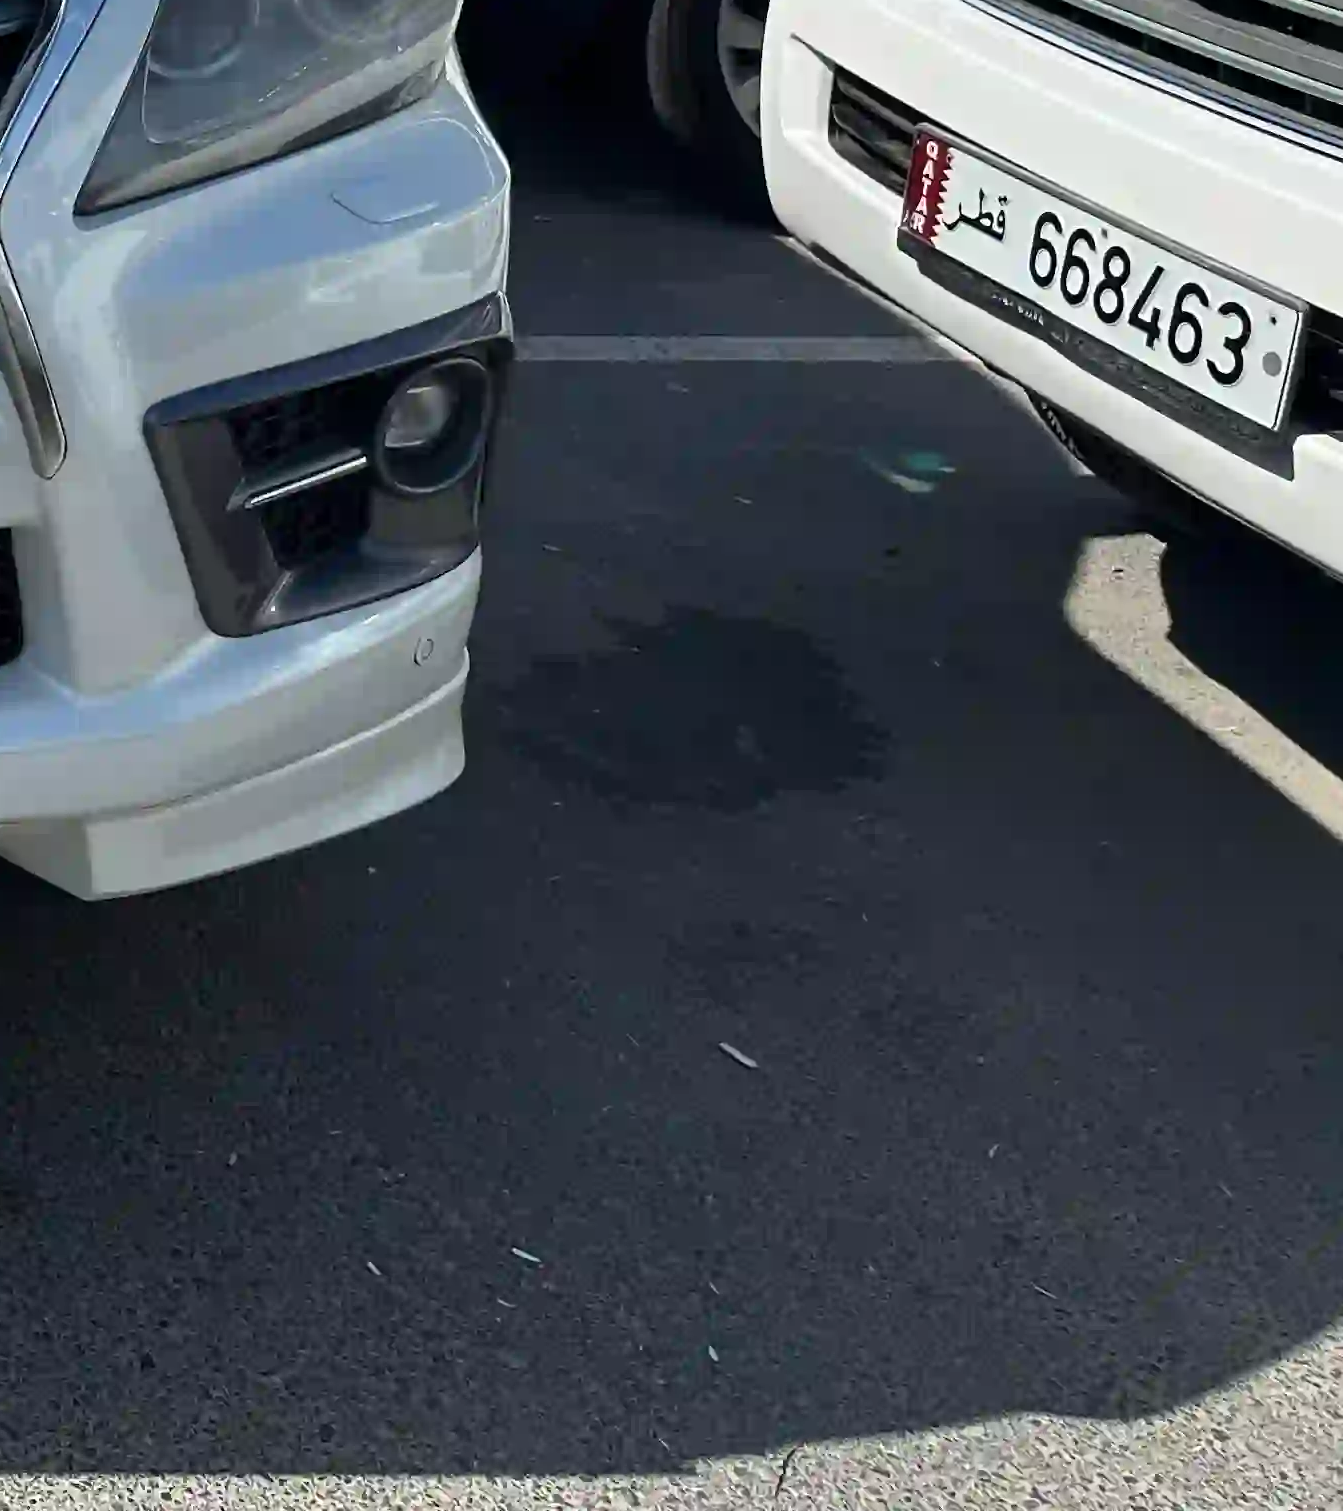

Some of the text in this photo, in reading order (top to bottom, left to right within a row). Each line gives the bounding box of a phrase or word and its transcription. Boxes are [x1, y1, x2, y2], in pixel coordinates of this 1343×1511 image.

[909, 140, 939, 235] QATAR
[941, 186, 1008, 243] قطر
[1028, 211, 1253, 387] 668463
